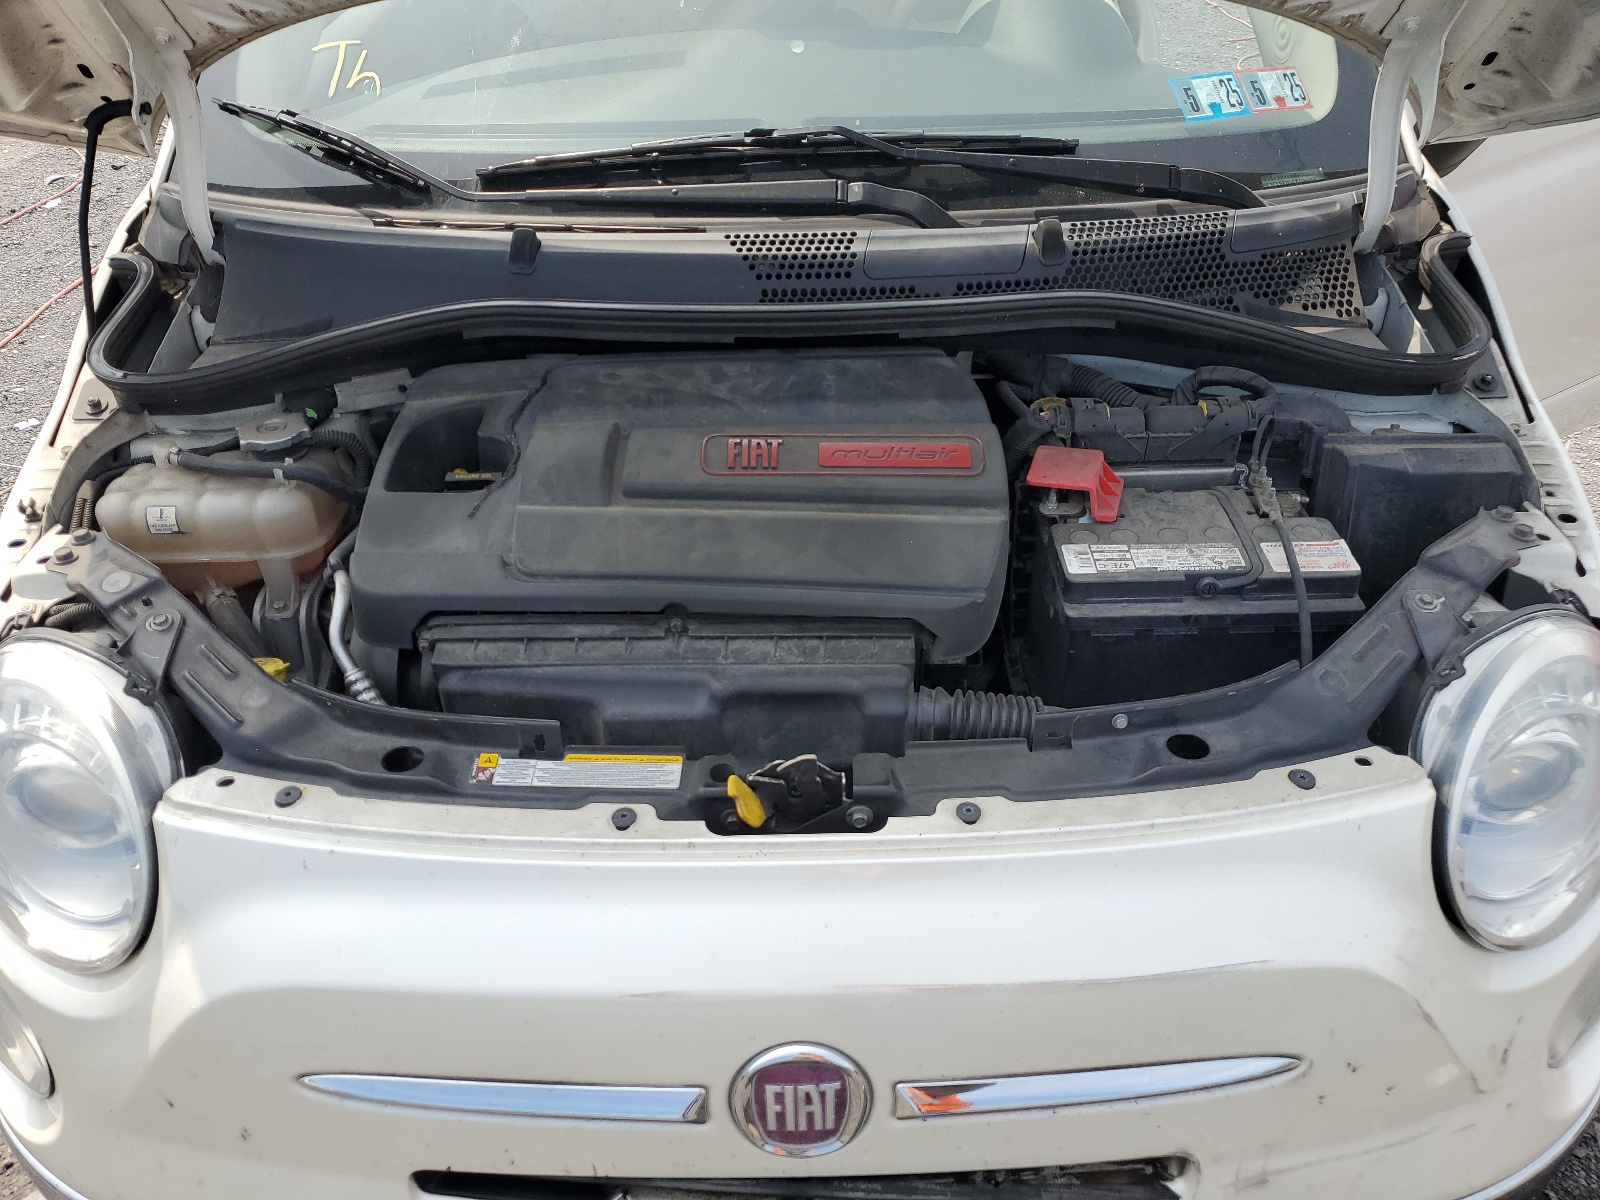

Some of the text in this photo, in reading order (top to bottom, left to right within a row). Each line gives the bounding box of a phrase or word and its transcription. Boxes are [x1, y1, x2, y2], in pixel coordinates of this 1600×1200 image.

[1183, 86, 1200, 113] 5
[1218, 77, 1244, 108] 25
[1250, 80, 1267, 106] 5
[1283, 72, 1307, 102] 25
[727, 438, 960, 469] FIAT multiair
[764, 1082, 841, 1131] FIAT
